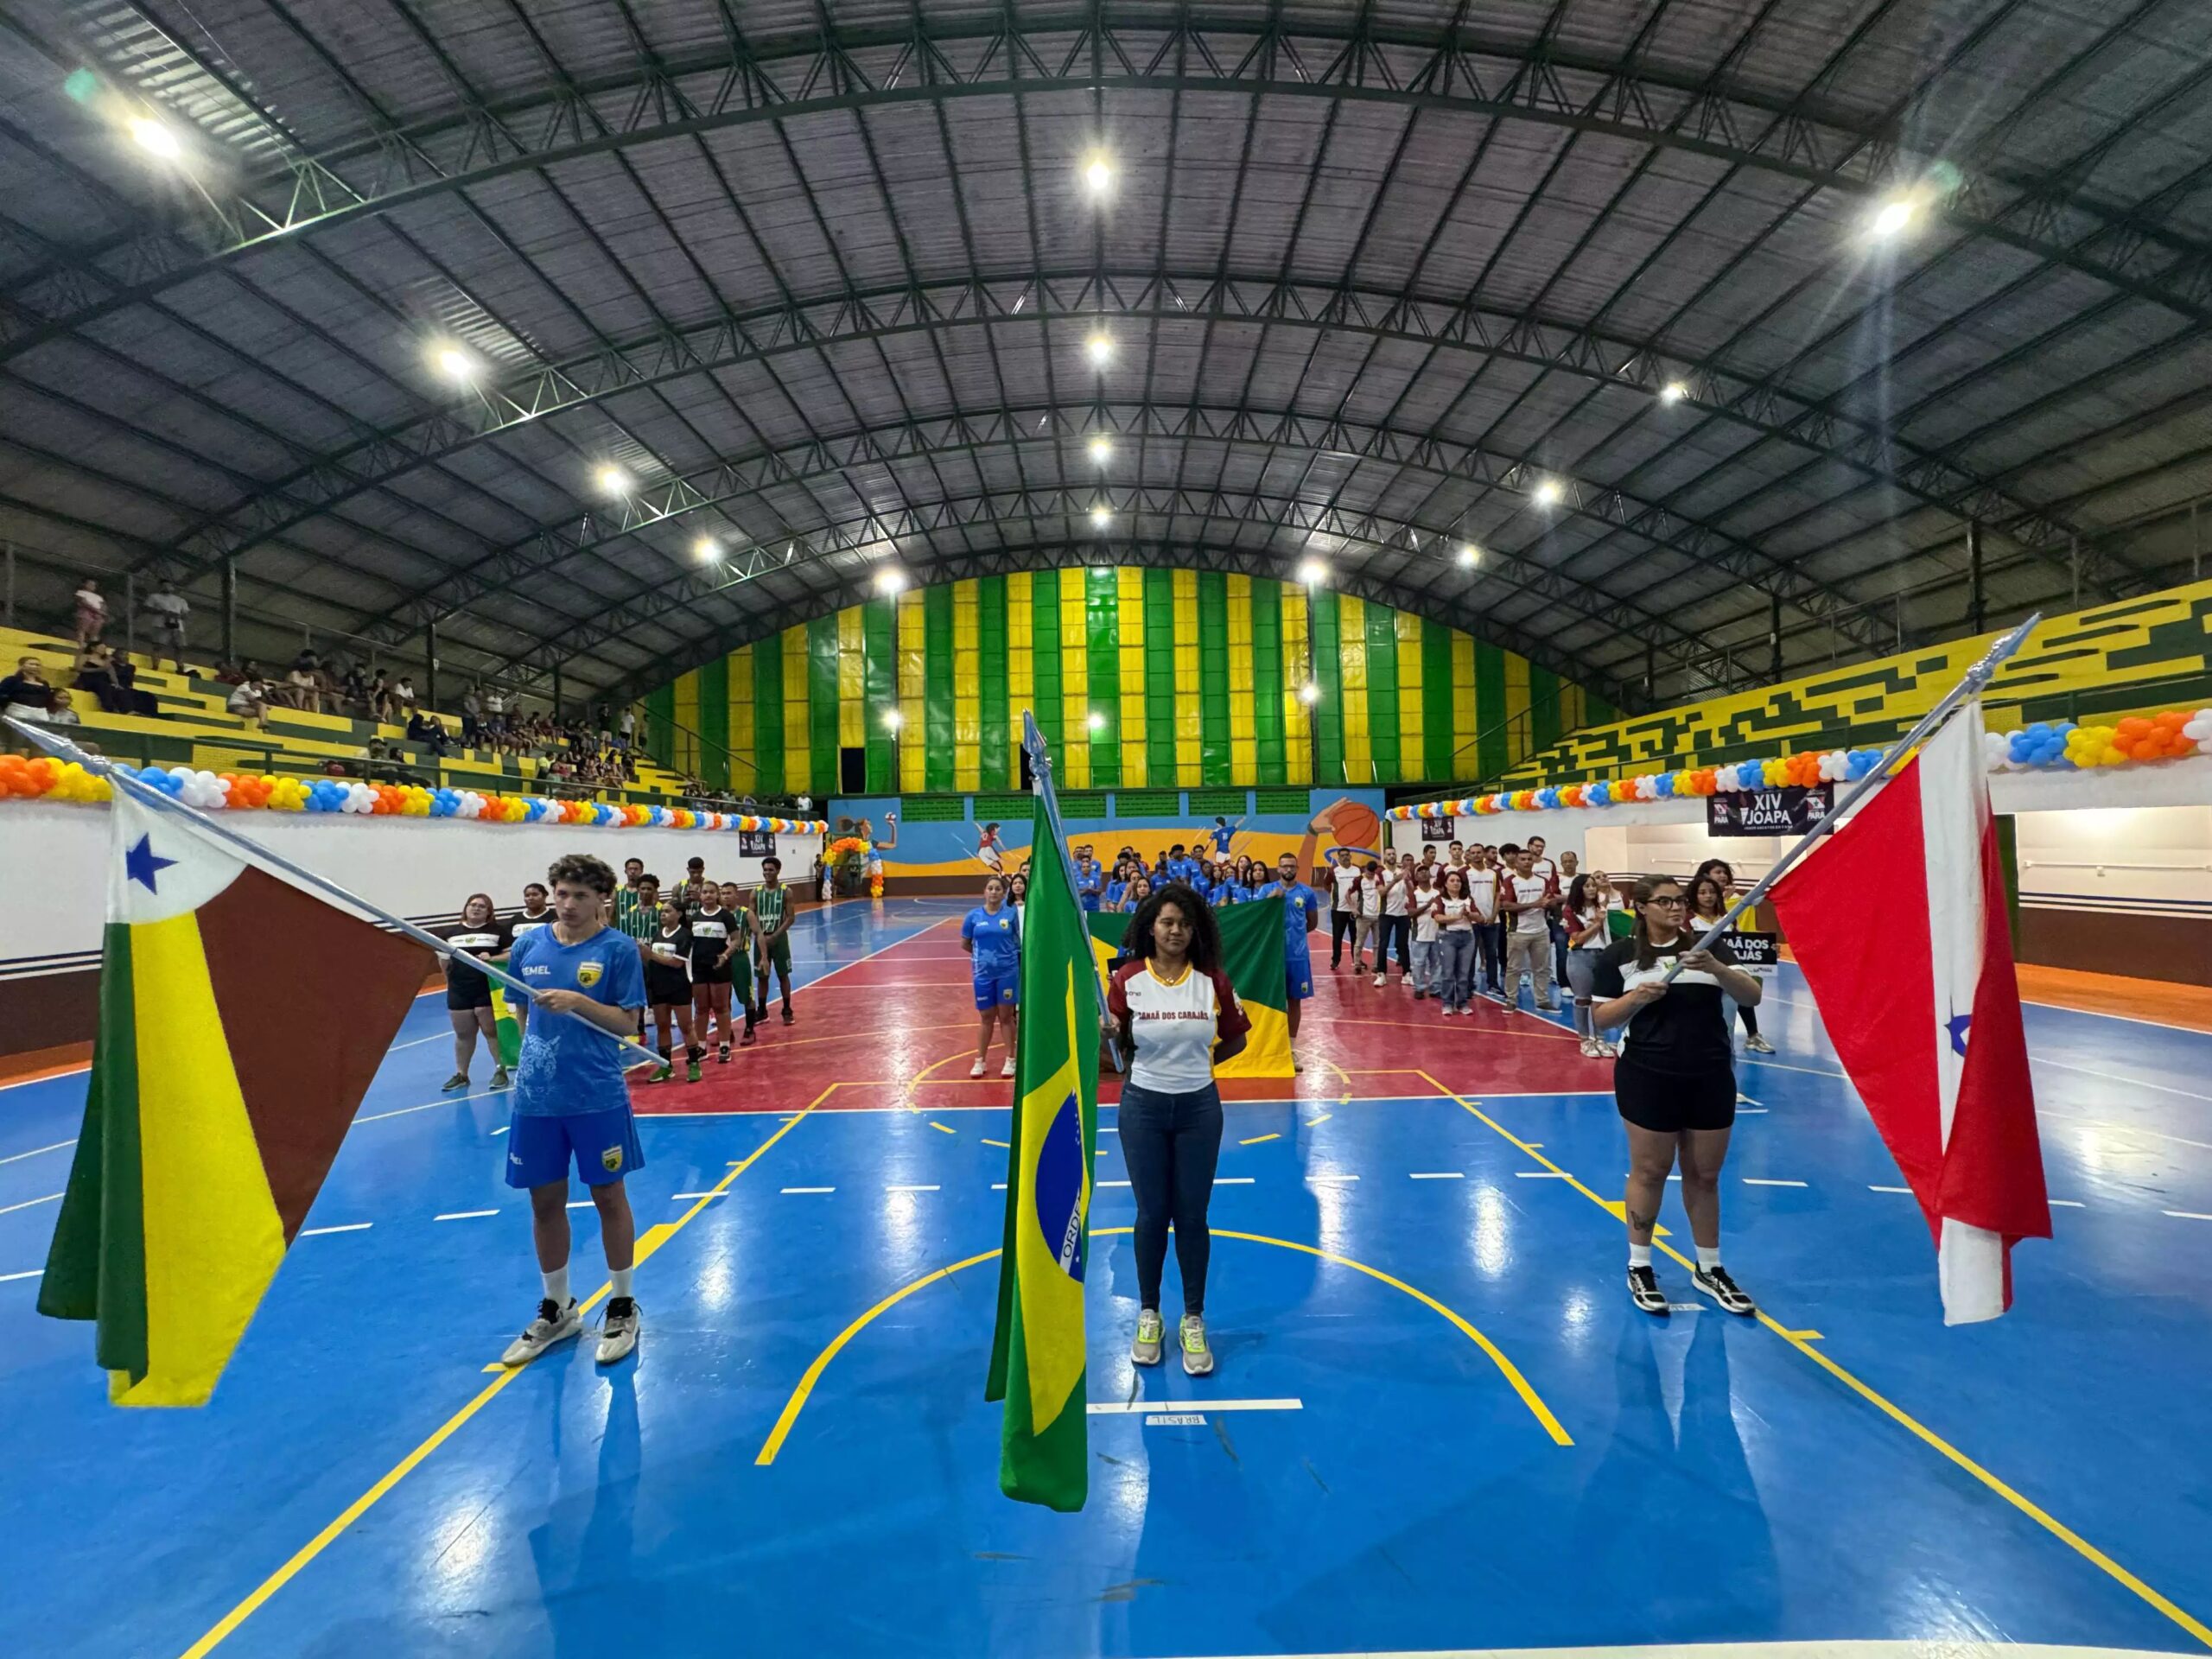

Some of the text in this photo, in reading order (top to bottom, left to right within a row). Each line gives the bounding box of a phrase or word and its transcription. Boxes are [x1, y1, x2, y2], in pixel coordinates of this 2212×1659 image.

[1754, 793, 1782, 810] XIV
[1747, 810, 1792, 825] JOAPA
[1745, 939, 1769, 950] DOS
[1178, 1010, 1209, 1020] CARAJÁS
[1063, 1196, 1081, 1258] ORDE
[1152, 1415, 1200, 1424] BRASIL
